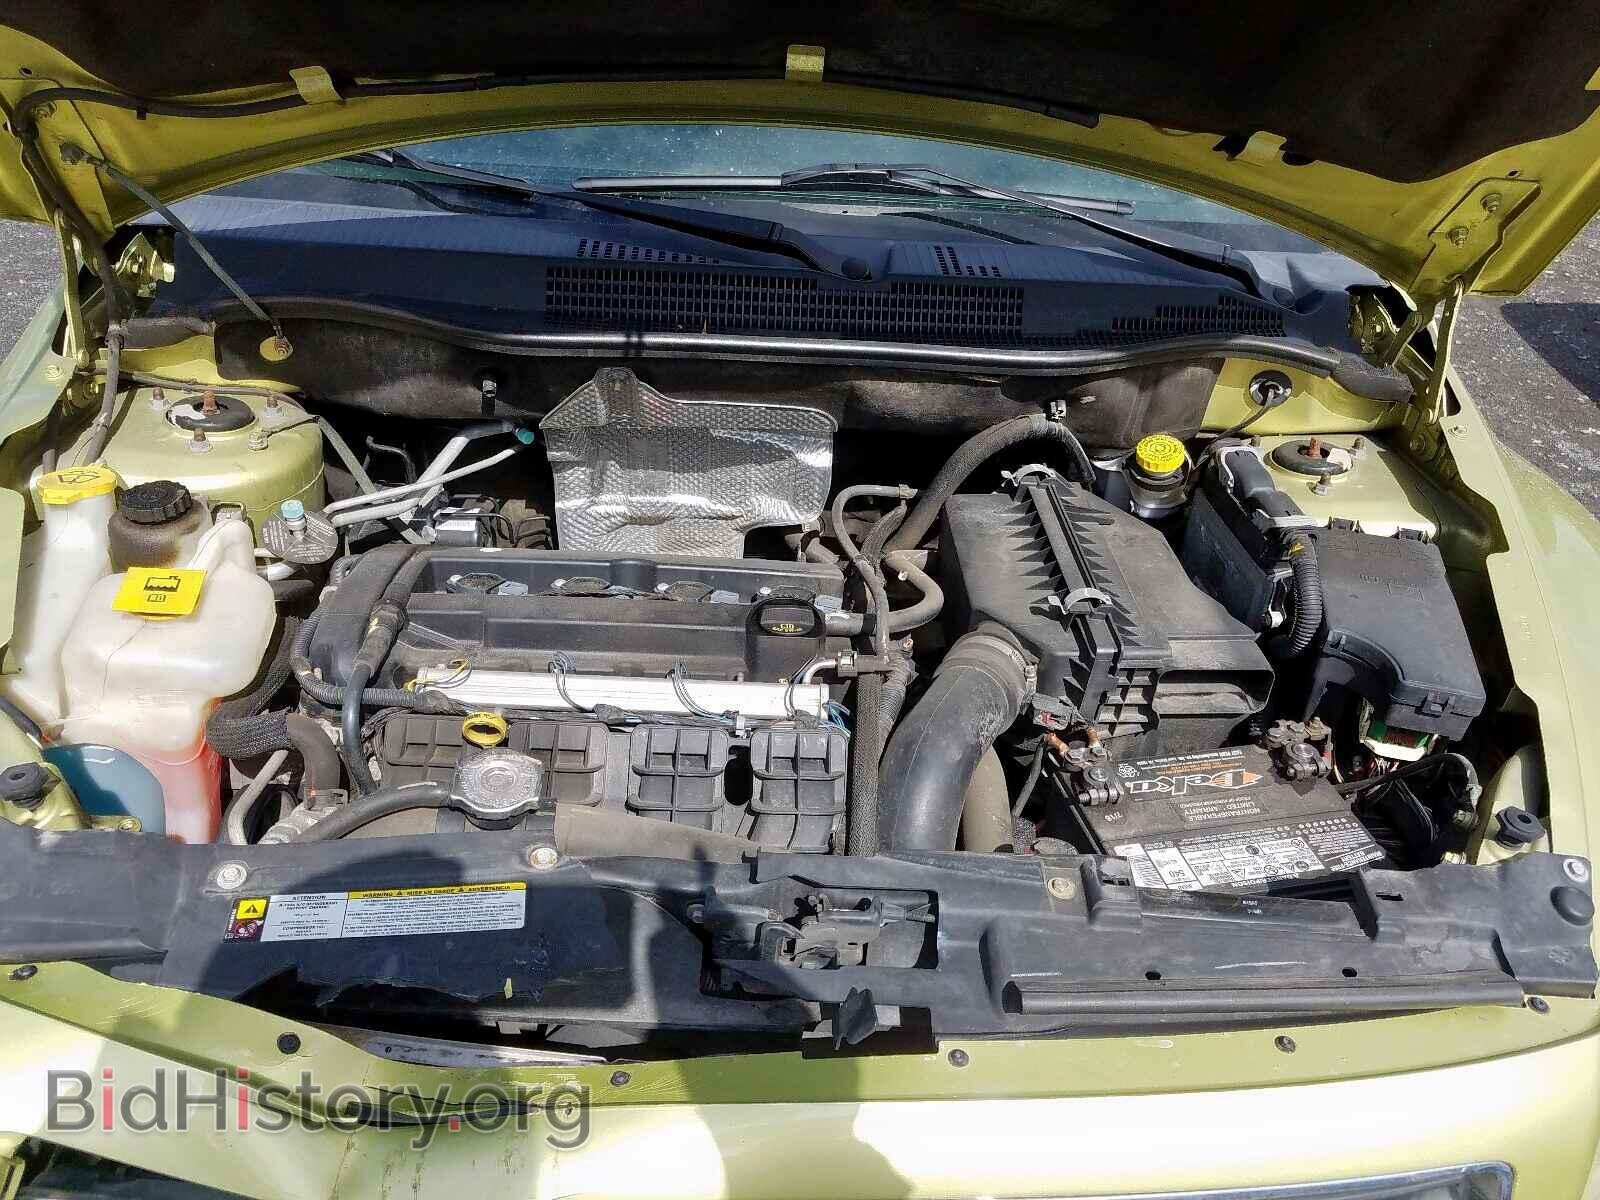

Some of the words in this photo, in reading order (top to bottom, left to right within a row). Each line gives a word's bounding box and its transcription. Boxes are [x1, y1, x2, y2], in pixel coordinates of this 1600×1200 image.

[1130, 769, 1264, 795] Deka
[1226, 801, 1255, 810] LIMITED
[1341, 850, 1364, 862] BATTERY
